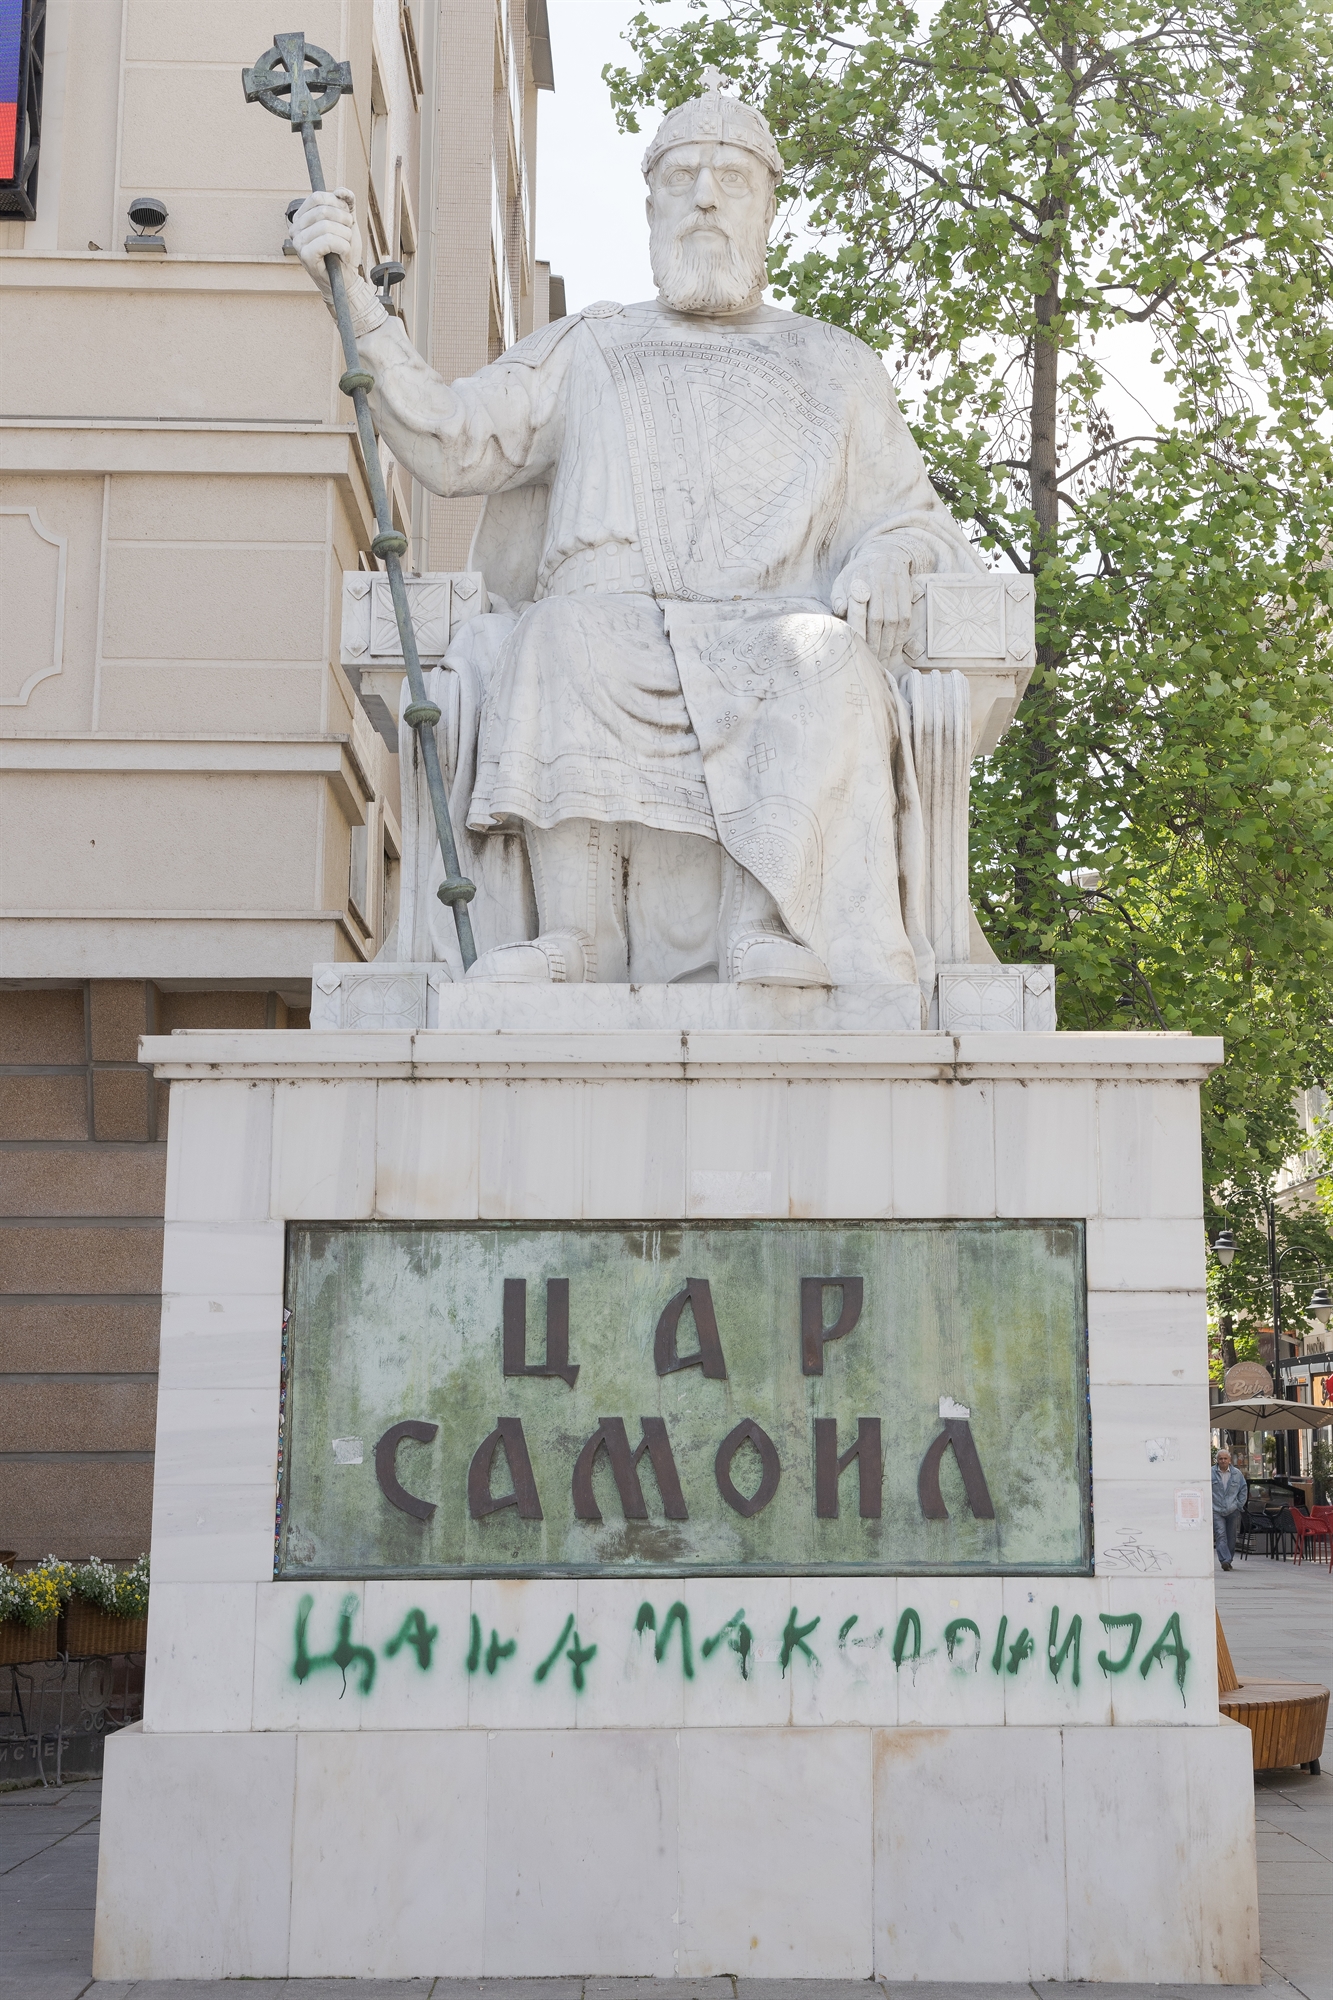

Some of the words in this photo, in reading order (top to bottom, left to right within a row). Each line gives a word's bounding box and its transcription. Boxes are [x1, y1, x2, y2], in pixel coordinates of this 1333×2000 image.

[503, 1276, 864, 1389] ЦАР
[1227, 1379, 1272, 1397] Bistro
[375, 1417, 996, 1521] САМОИЛ
